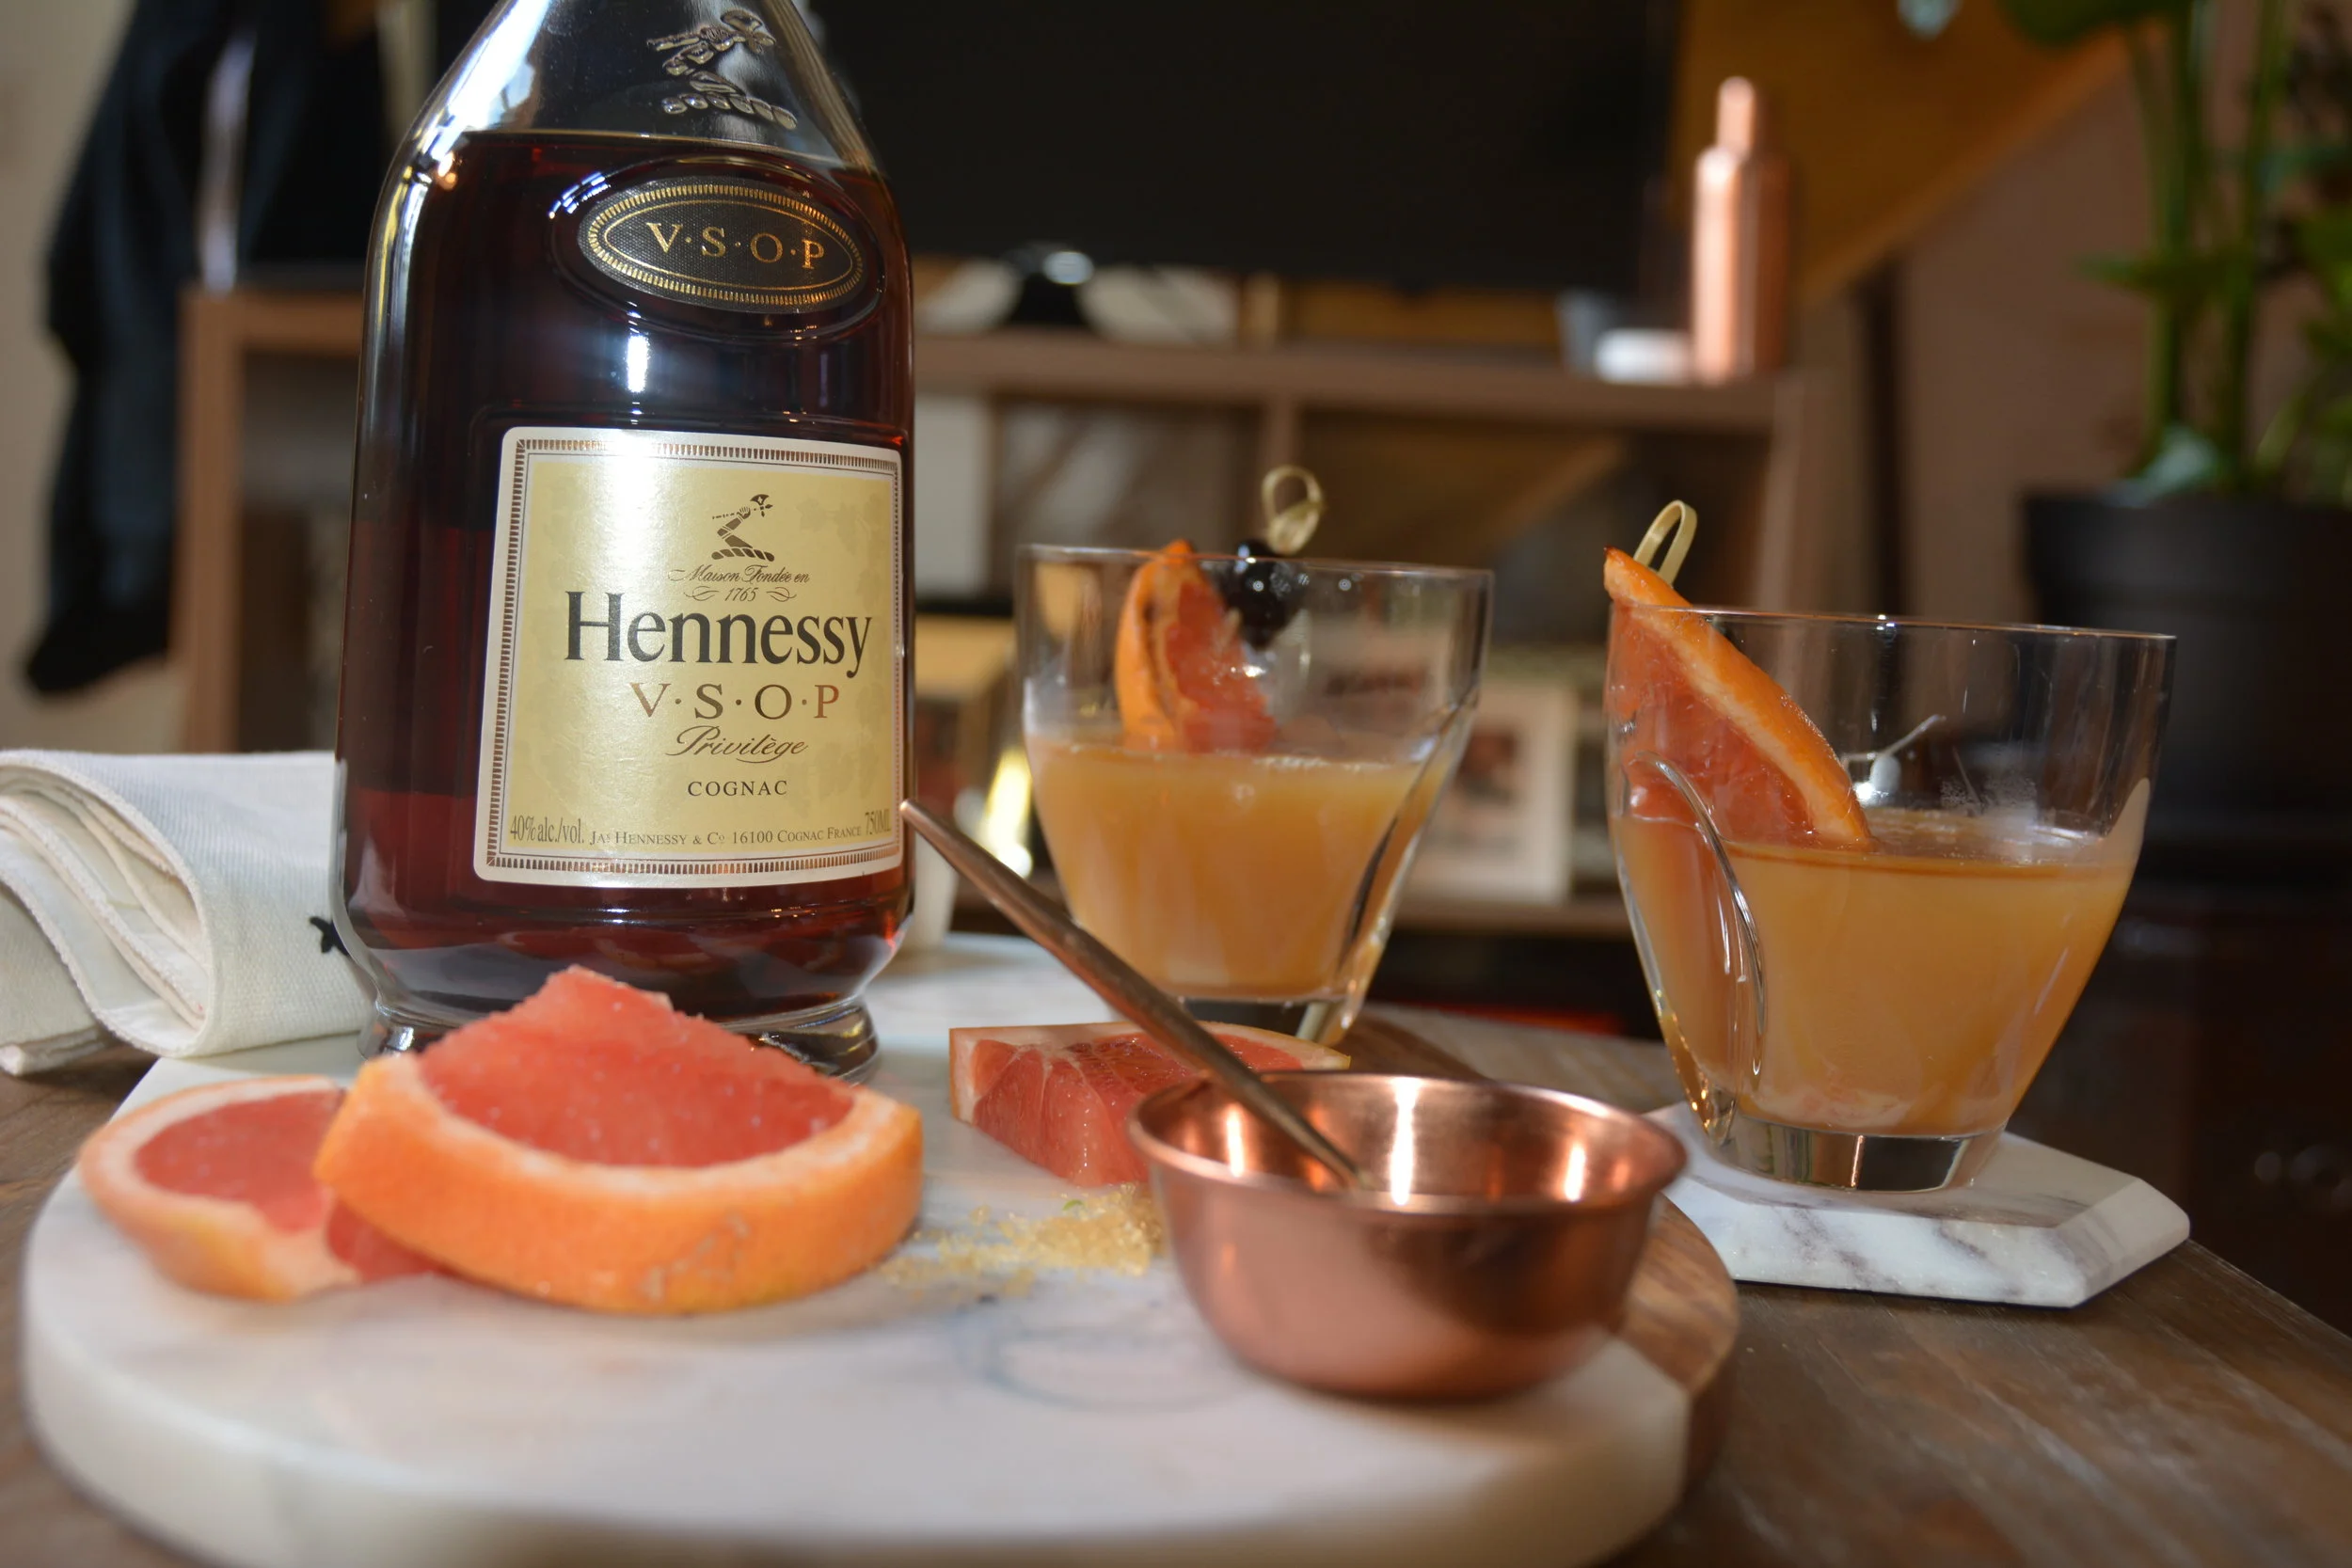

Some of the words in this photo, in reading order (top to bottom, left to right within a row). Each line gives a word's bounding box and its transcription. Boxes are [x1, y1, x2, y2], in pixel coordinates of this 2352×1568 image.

[669, 564, 740, 582] Maison
[741, 564, 791, 583] Fondée
[793, 572, 810, 583] en
[724, 587, 759, 602] 1765
[564, 591, 873, 678] Hennessy
[665, 725, 809, 764] Privilège
[687, 780, 788, 797] COGNAC
[692, 836, 702, 845] &
[732, 831, 773, 844] 16100
